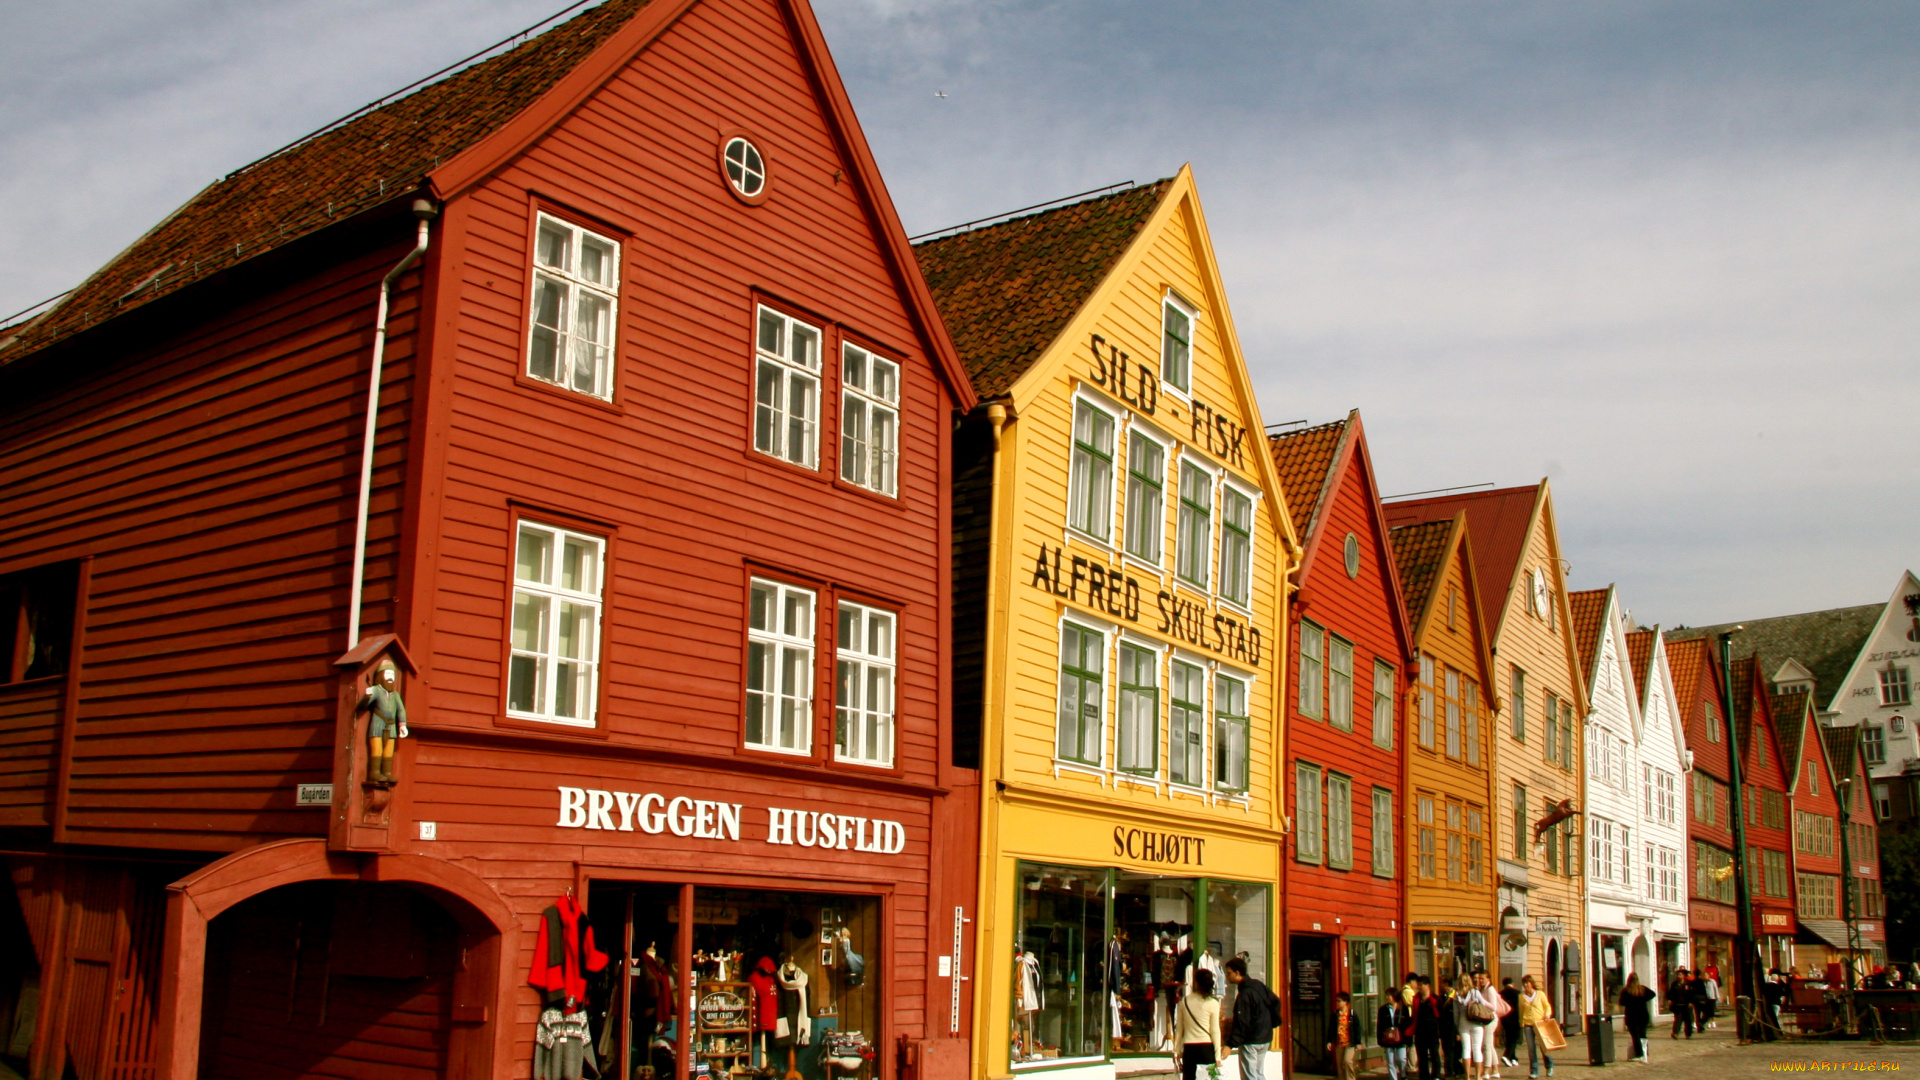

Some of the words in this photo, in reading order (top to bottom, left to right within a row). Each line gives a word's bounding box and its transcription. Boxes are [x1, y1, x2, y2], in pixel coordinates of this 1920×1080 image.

[1089, 333, 1158, 416] SILD
[1191, 398, 1247, 471] FISK
[1032, 541, 1140, 623] ALFRED
[1157, 590, 1261, 667] SKULSTAD
[301, 787, 330, 802] Bugården
[556, 785, 743, 842] BRYGGEN
[766, 806, 906, 855] HUSFLID
[1113, 825, 1206, 866] SCHJØTT
